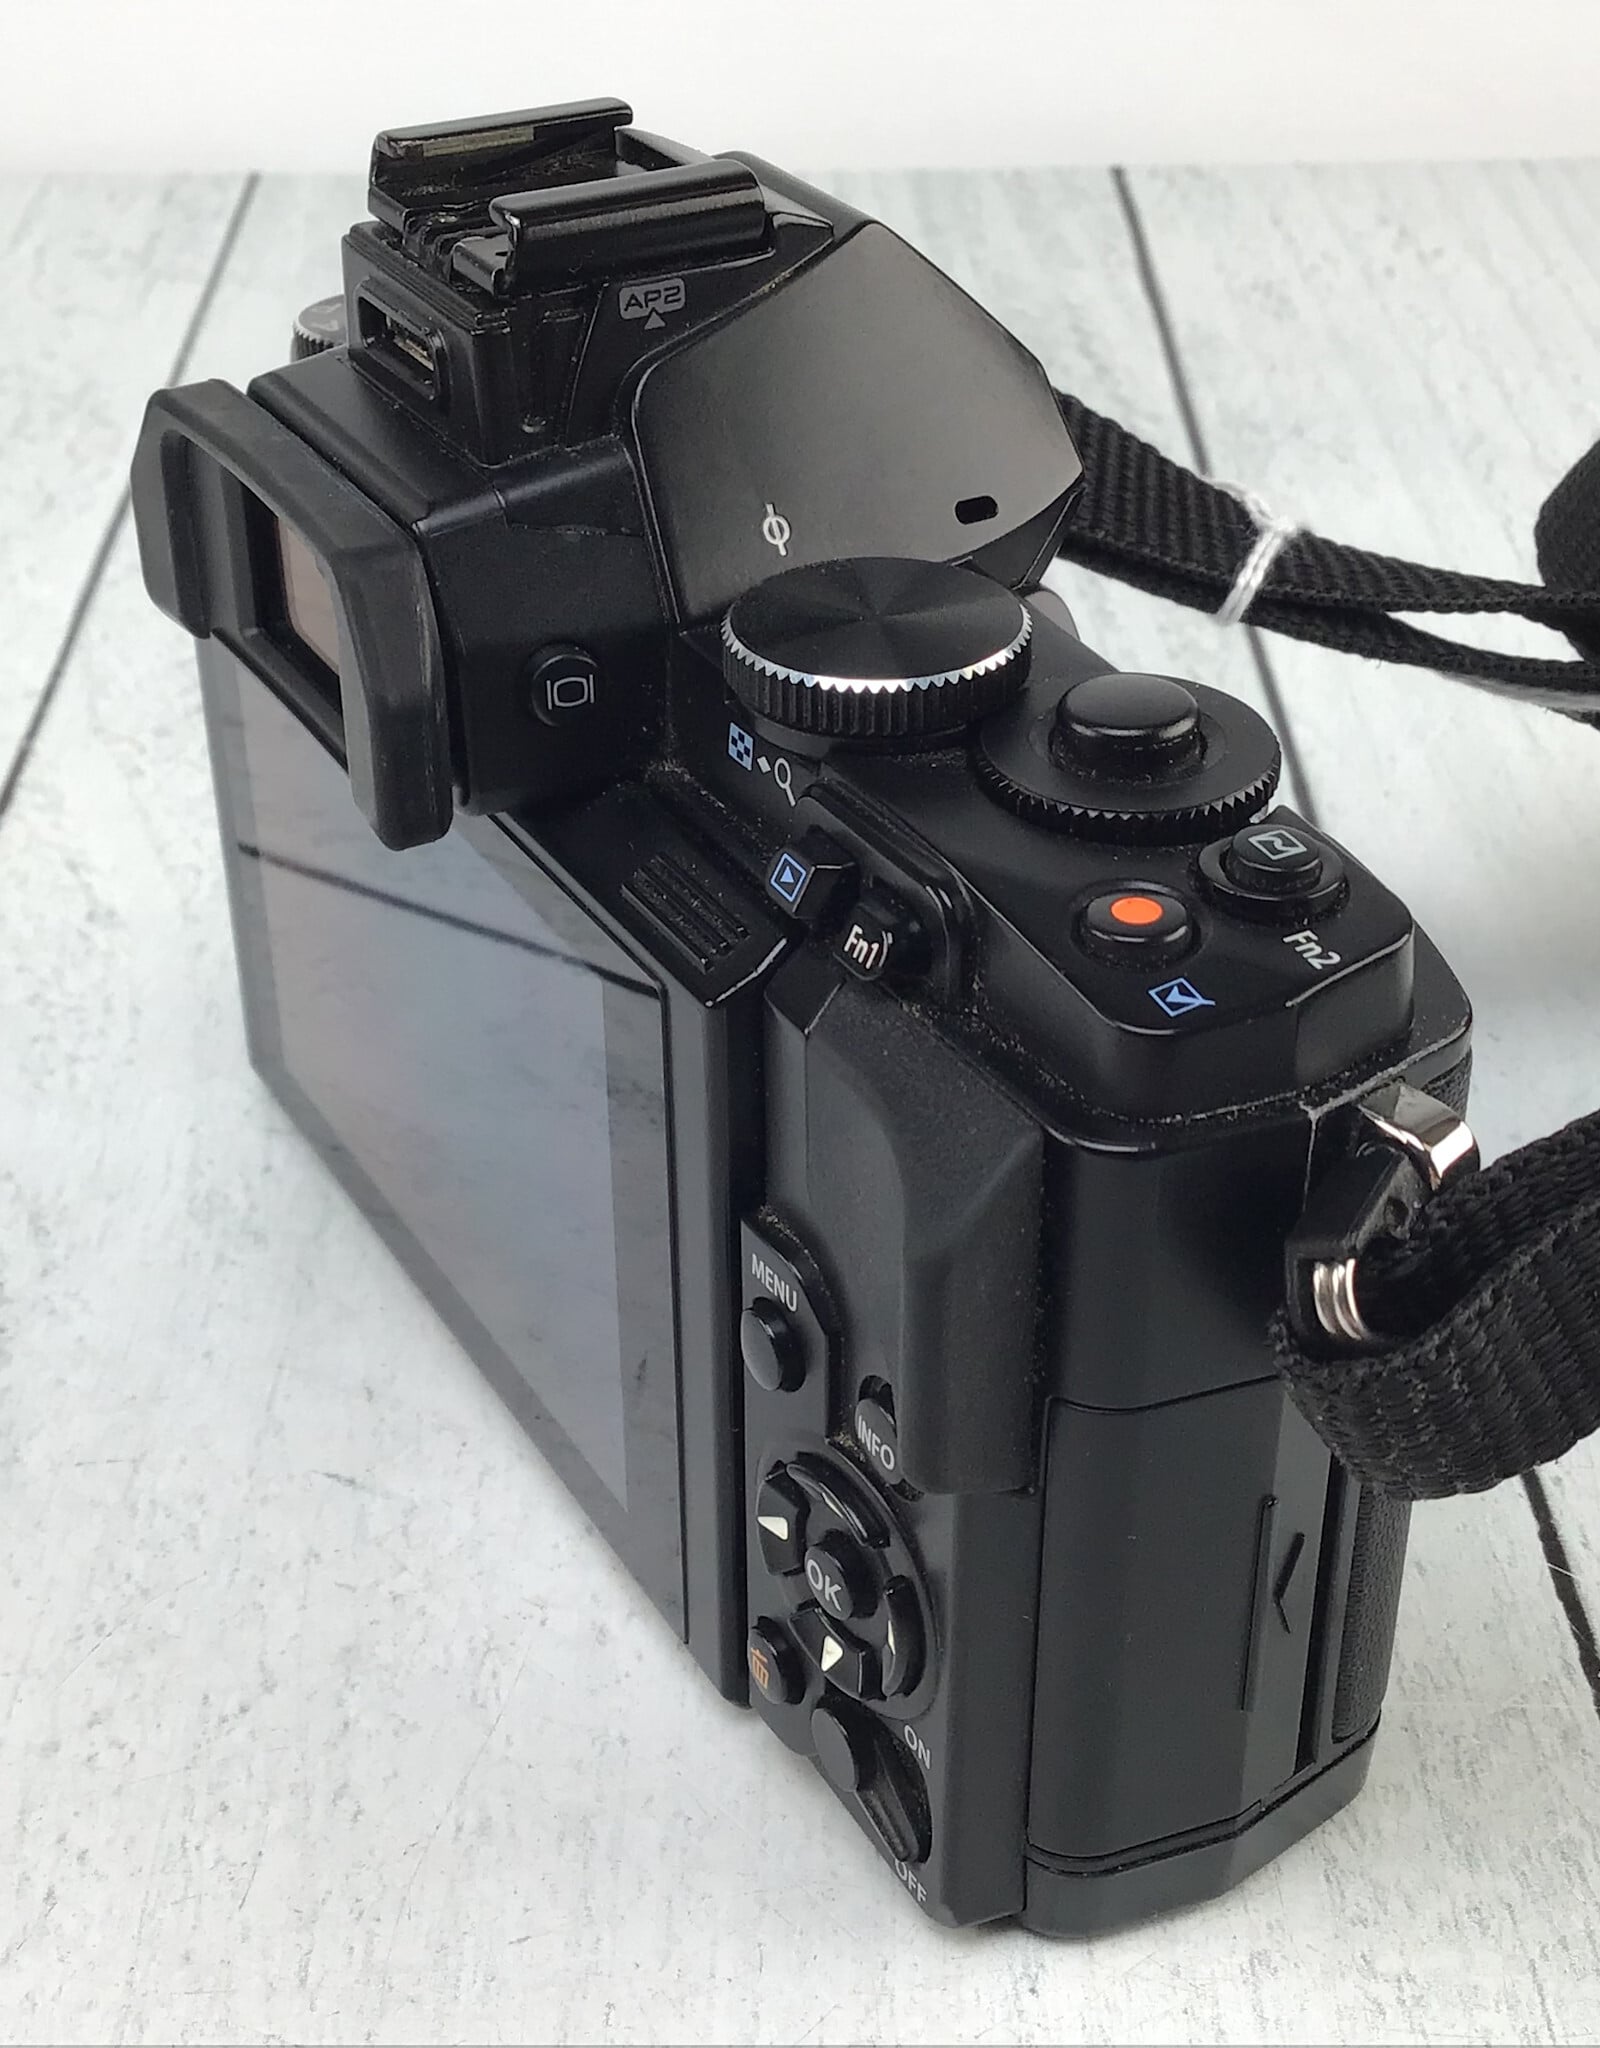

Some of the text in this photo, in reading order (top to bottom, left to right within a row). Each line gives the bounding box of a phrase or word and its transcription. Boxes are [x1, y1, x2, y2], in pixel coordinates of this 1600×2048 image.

[624, 285, 682, 312] AP2
[843, 924, 880, 970] Fn1
[1282, 930, 1341, 970] Fn2
[751, 1253, 798, 1312] MENU
[857, 1414, 895, 1471] INFO
[806, 1558, 842, 1612] OK
[904, 1724, 931, 1770] ON
[894, 1858, 928, 1903] OFF
